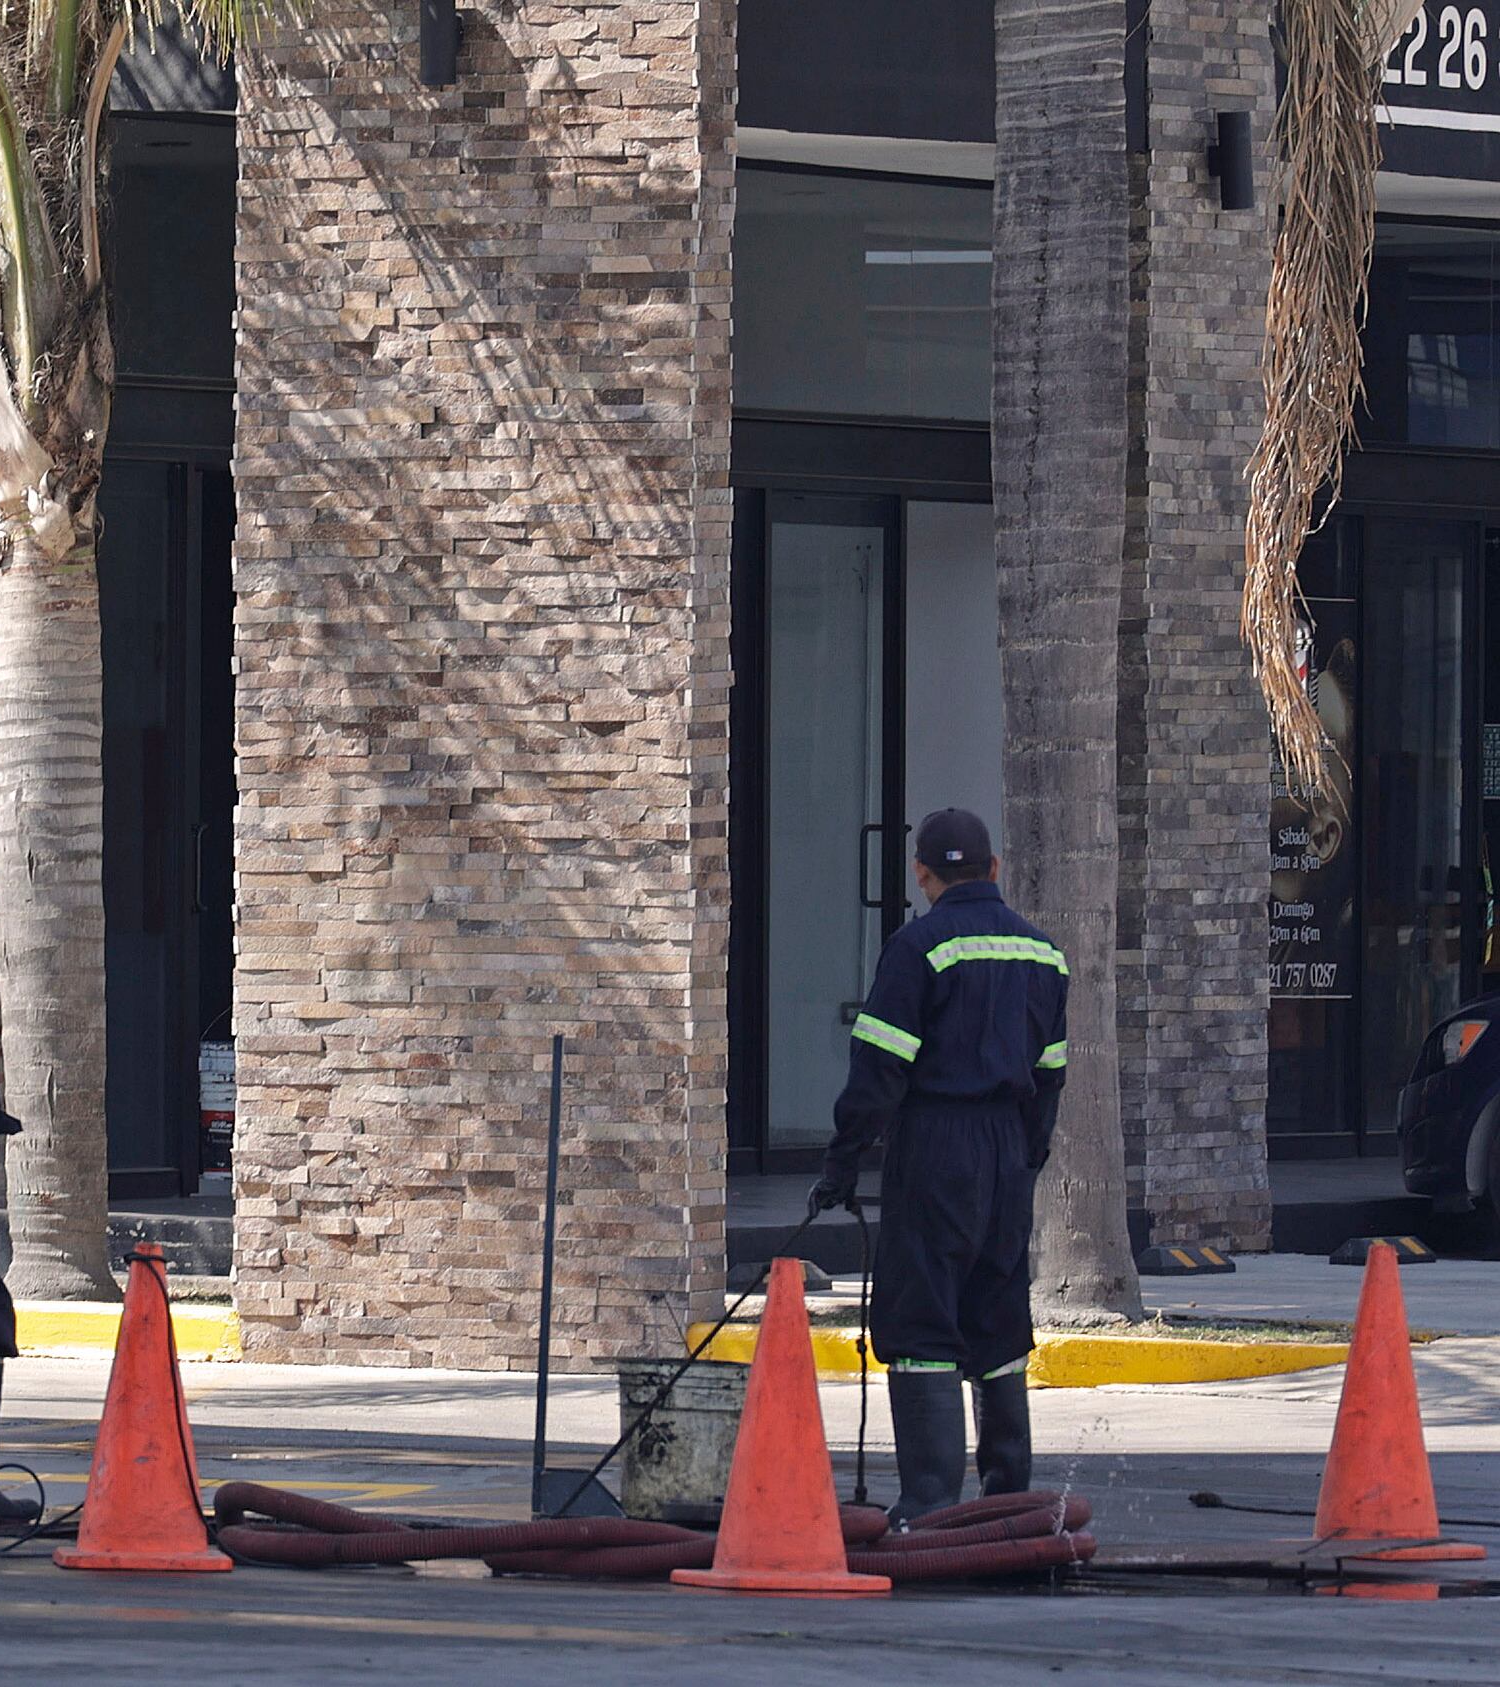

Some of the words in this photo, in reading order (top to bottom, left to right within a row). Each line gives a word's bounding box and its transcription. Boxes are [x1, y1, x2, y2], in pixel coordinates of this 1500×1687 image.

[1381, 6, 1427, 86] 2
[1438, 5, 1487, 90] 26
[1278, 826, 1310, 847] Sábado
[1293, 856, 1298, 869] a
[1274, 899, 1314, 921] Domingo
[1292, 928, 1298, 940] a
[1301, 925, 1320, 945] 6pm
[1285, 963, 1307, 988] 757
[1310, 962, 1337, 988] 0287
